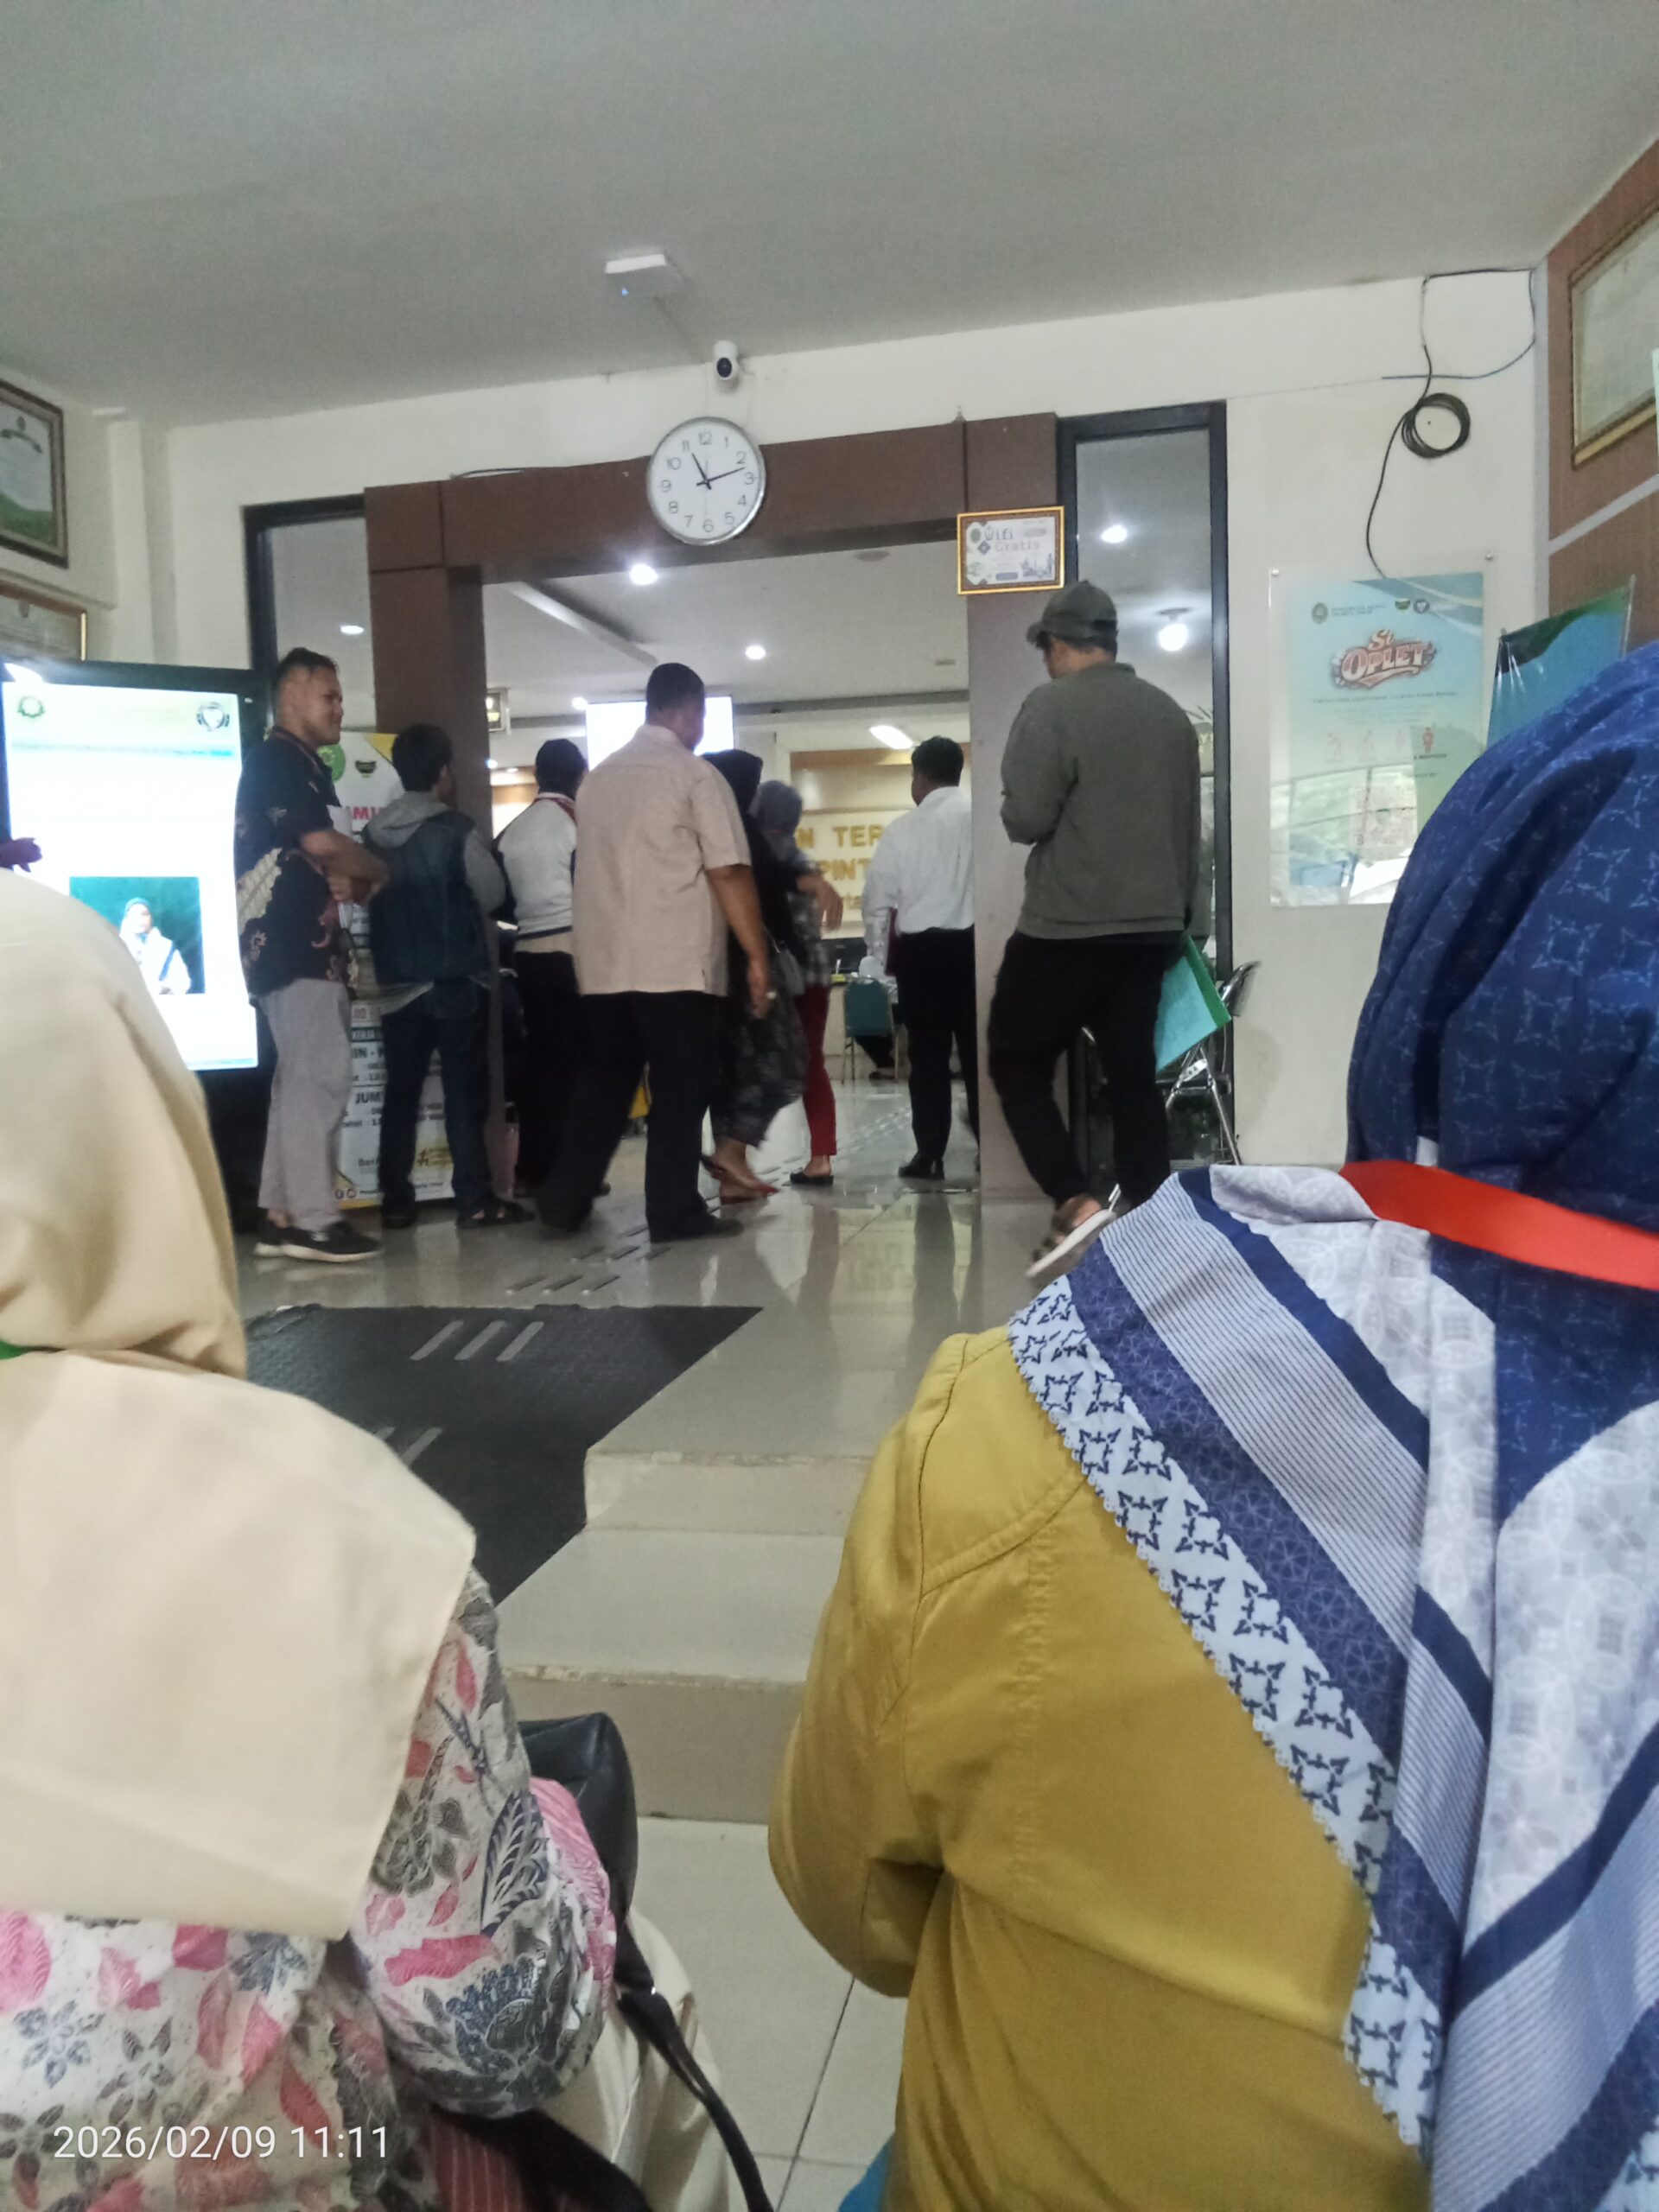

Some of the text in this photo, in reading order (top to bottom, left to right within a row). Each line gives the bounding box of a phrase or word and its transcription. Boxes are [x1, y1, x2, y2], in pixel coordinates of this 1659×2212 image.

[698, 432, 712, 446] 12
[724, 436, 729, 448] 1
[682, 441, 690, 453] 11
[667, 458, 681, 470] 10
[736, 451, 747, 465] 2
[744, 472, 754, 486] 3
[661, 480, 671, 493] 9
[738, 495, 747, 506] 4
[669, 501, 678, 514] 8
[684, 516, 693, 528] 7
[725, 512, 734, 524] 5
[703, 520, 714, 533] 6
[995, 541, 1040, 552] Gratis
[1341, 642, 1427, 682] OPLET
